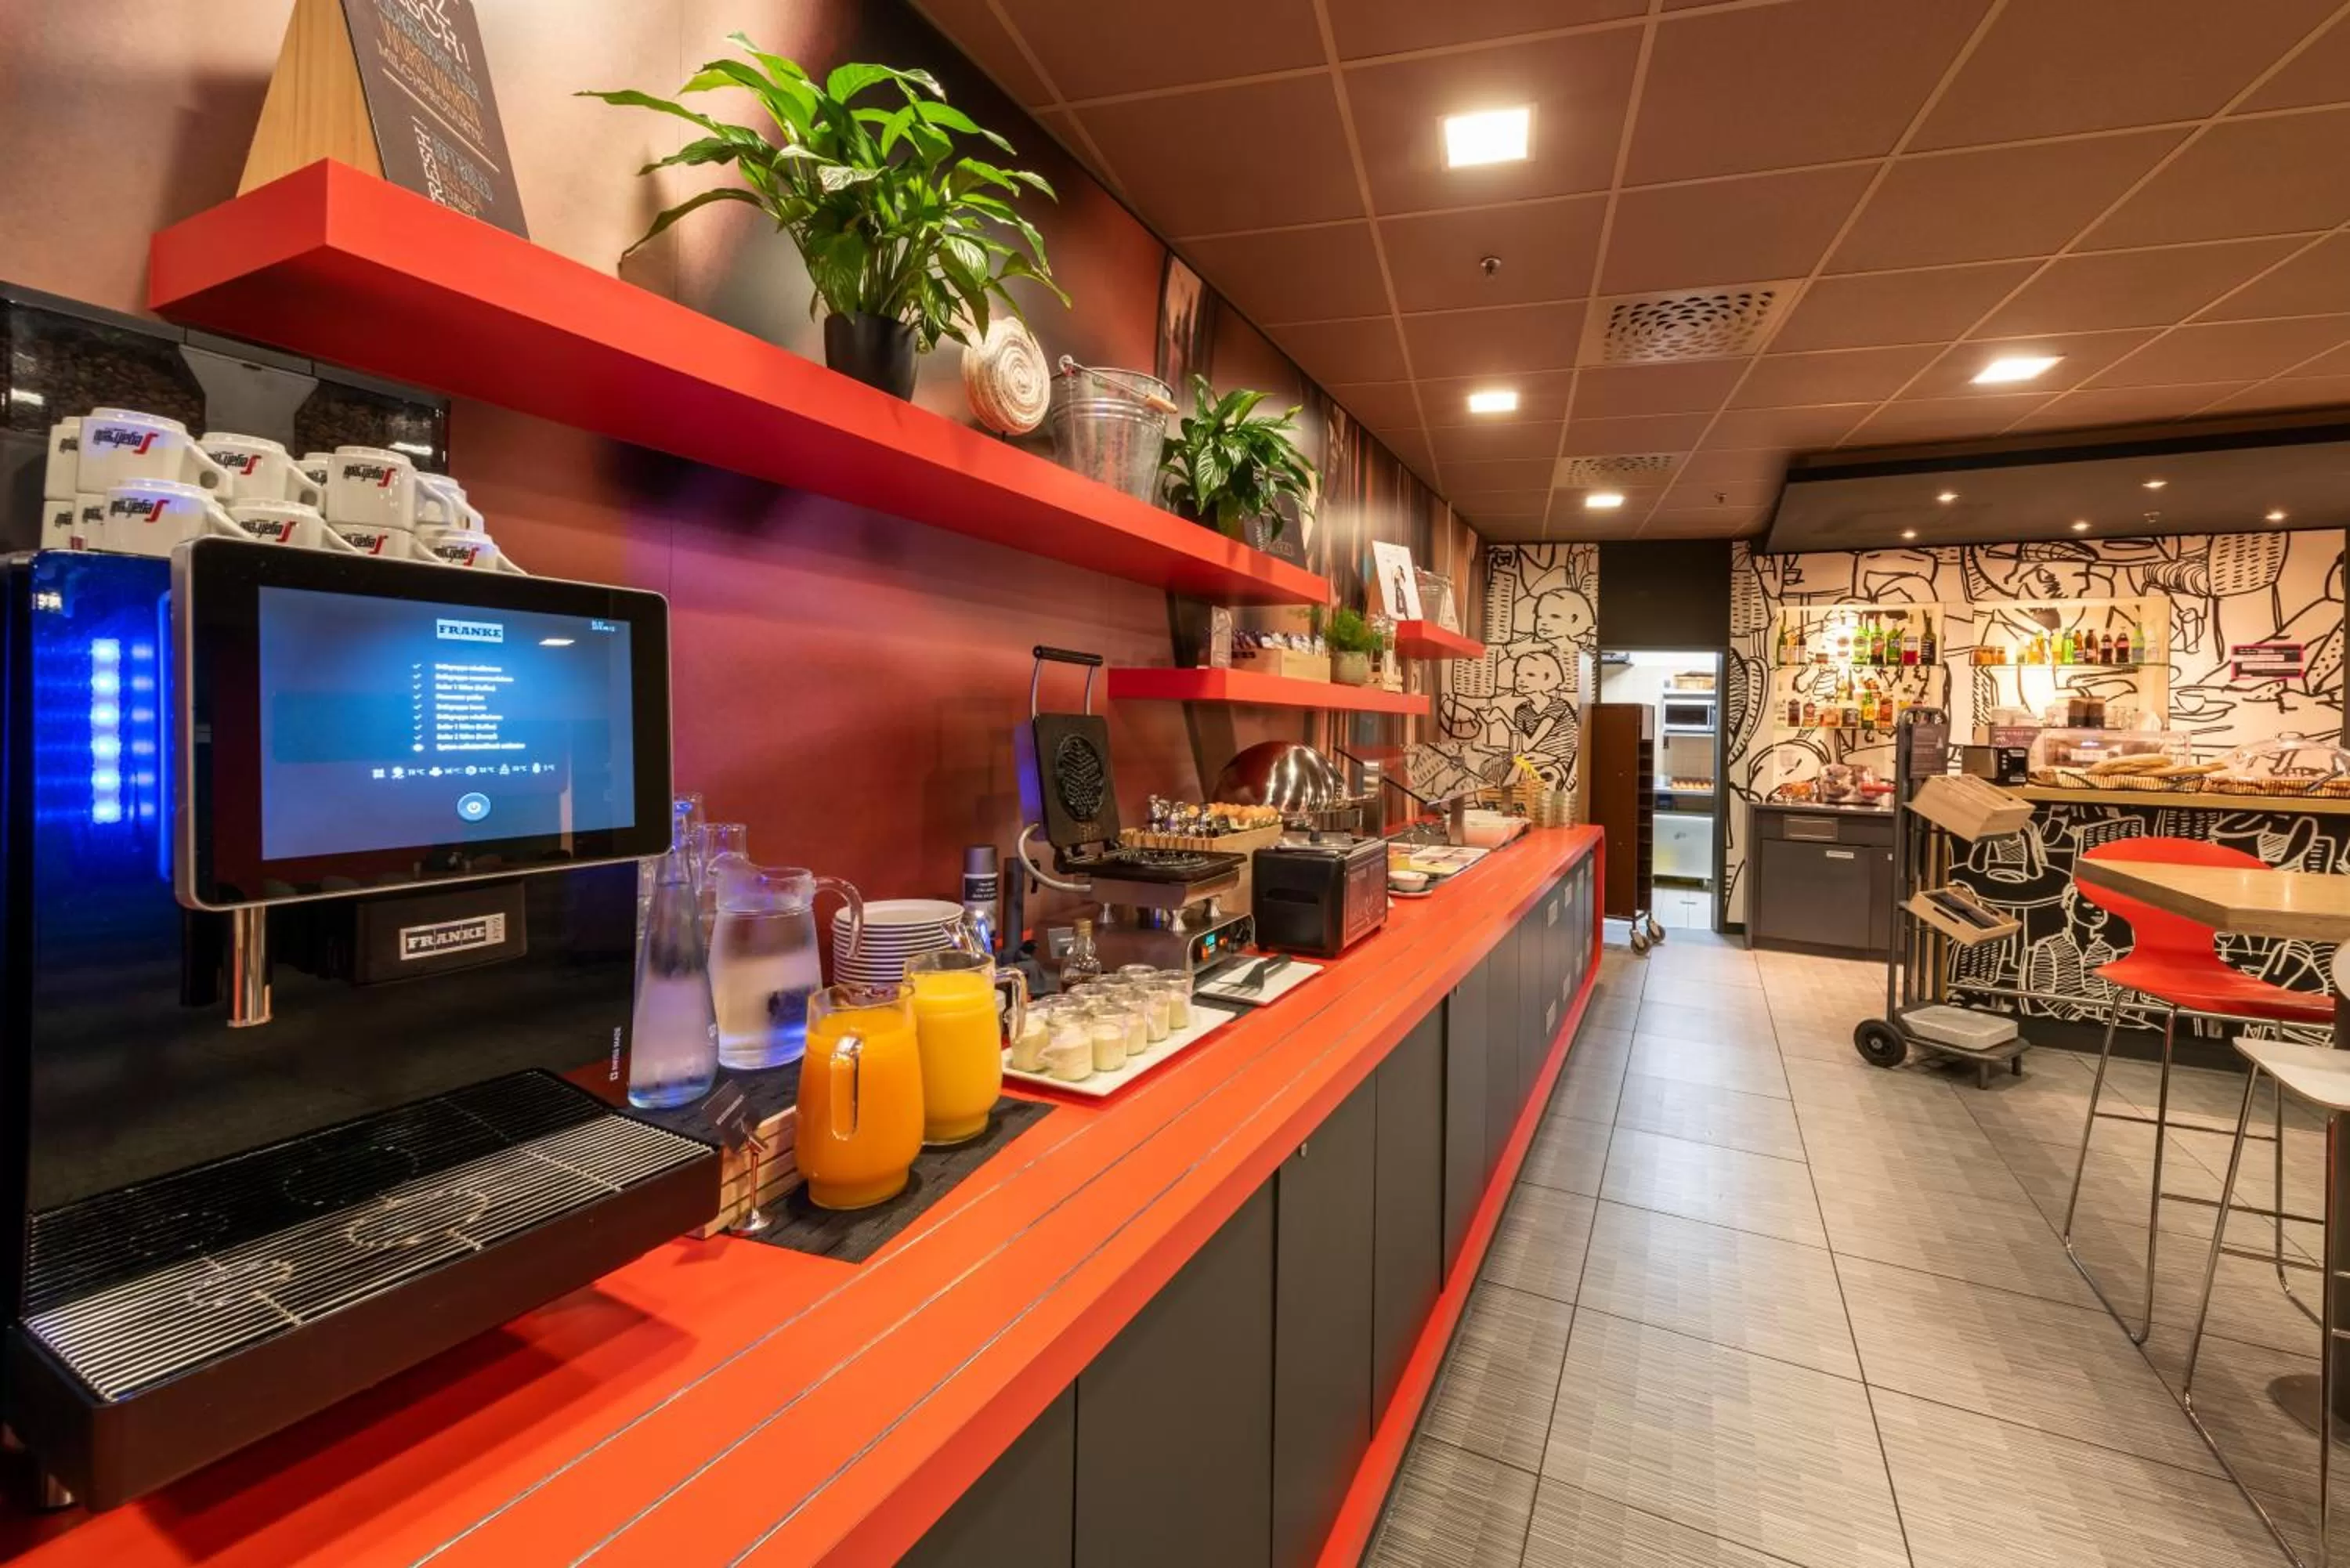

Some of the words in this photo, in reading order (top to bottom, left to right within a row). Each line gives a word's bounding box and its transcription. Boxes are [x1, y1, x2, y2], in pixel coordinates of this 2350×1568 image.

[399, 0, 471, 72] SCH!
[411, 115, 446, 207] RESH!
[439, 624, 502, 638] FRANKE
[407, 927, 486, 951] FRANKE
